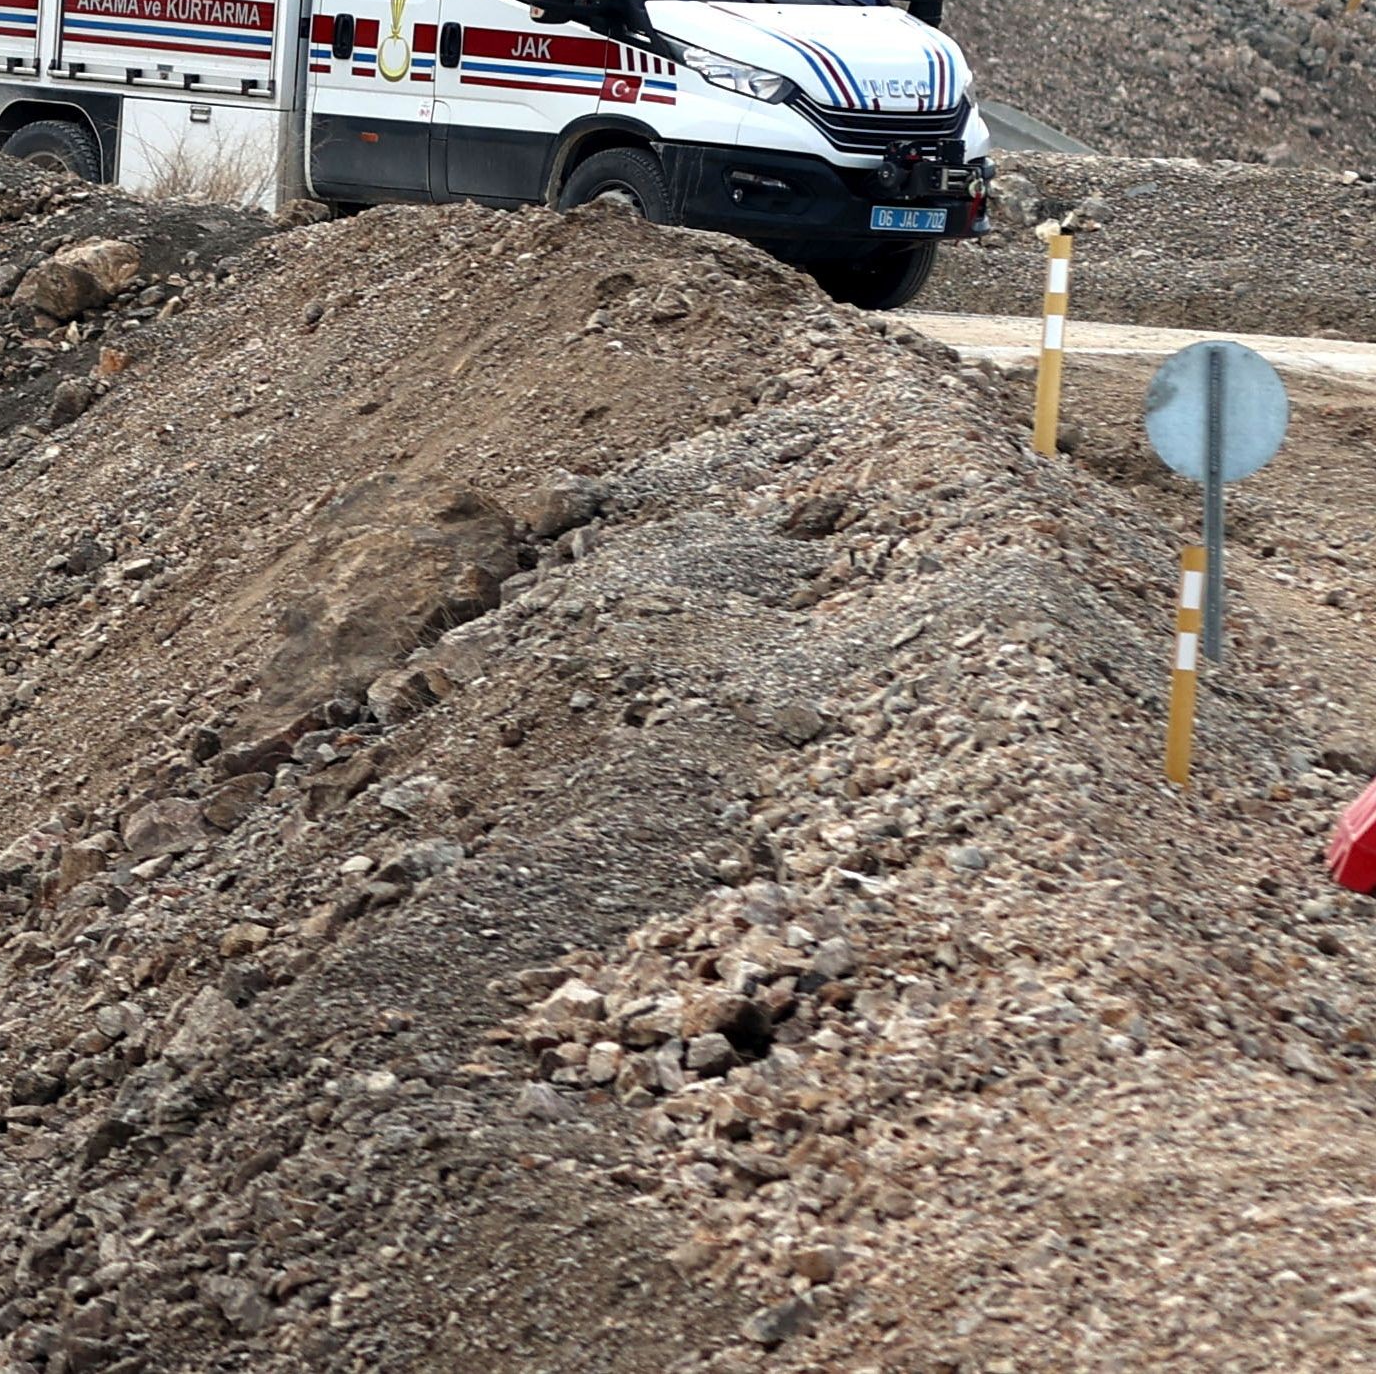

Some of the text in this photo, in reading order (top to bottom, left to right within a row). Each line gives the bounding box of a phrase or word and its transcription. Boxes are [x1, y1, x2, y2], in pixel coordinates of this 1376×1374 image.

[142, 0, 161, 17] ve
[511, 35, 552, 59] JAK
[861, 79, 931, 98] IVECO
[878, 209, 945, 229] 06 JAC 702
